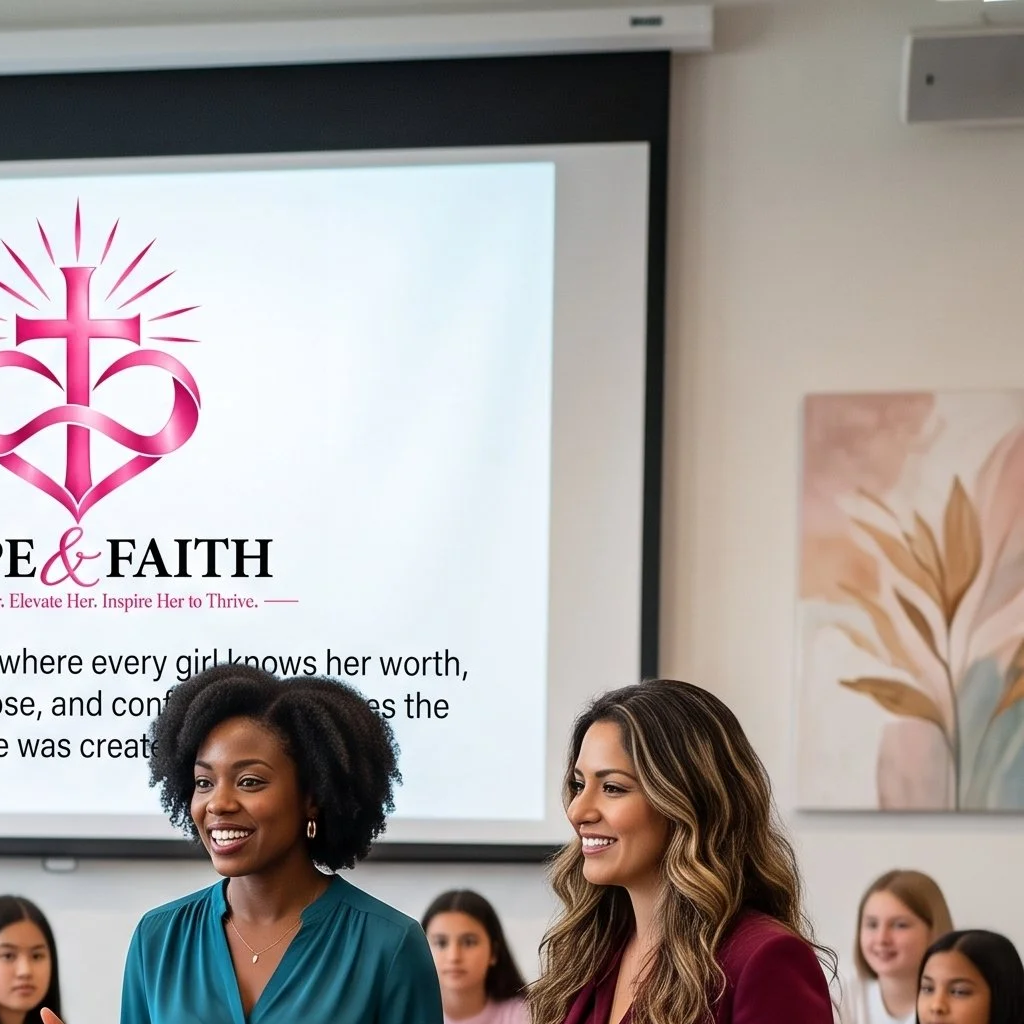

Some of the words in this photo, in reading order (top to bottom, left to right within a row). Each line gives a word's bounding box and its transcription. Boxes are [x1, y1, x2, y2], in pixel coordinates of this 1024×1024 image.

[40, 526, 102, 588] &
[106, 538, 274, 578] FAITH
[9, 592, 63, 609] Elevate
[66, 592, 98, 609] Her.
[102, 592, 153, 613] Inspire
[156, 592, 185, 609] Her
[188, 595, 203, 609] to
[205, 592, 259, 609] Thrive.
[91, 654, 168, 682] every
[175, 647, 218, 682] girl
[228, 647, 318, 676] knows
[326, 648, 372, 676] her
[379, 648, 468, 682] worth,
[51, 689, 102, 717] and
[403, 691, 450, 720] the
[17, 738, 71, 759] was
[79, 732, 159, 760] create
